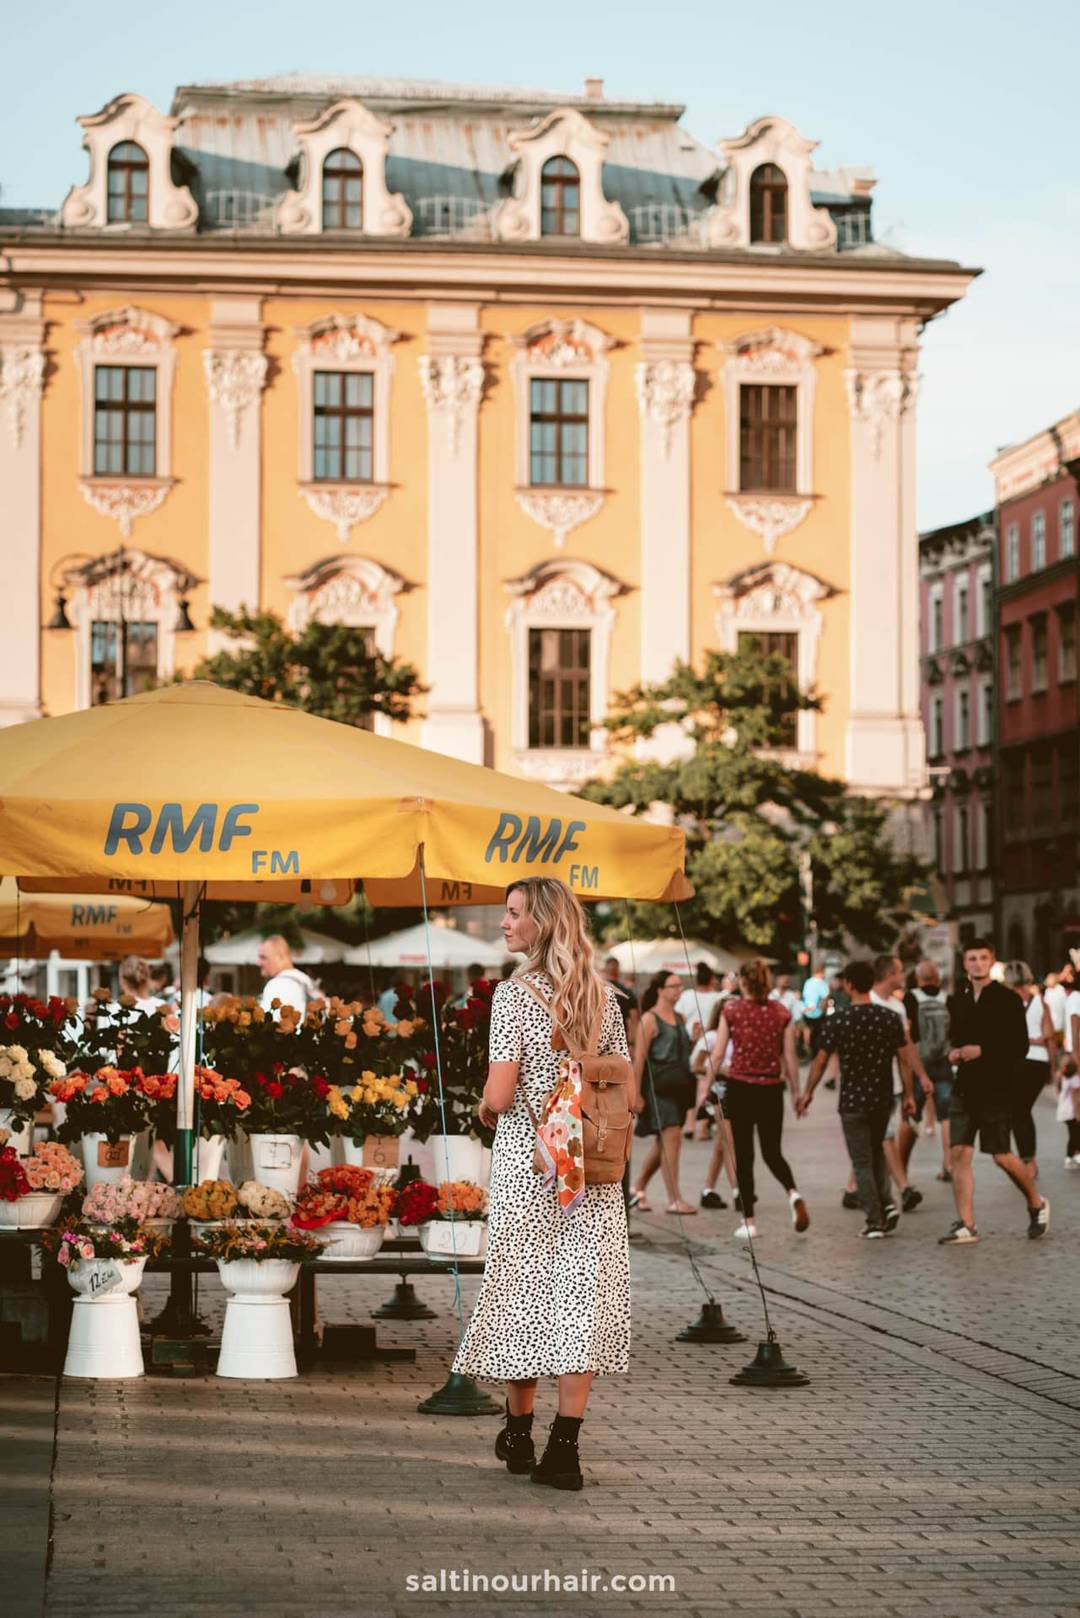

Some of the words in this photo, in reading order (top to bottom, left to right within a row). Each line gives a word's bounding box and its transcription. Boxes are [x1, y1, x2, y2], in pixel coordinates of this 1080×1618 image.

[104, 803, 259, 855] RMF
[252, 851, 299, 873] FM
[484, 813, 586, 863] RMF
[569, 864, 599, 888] FM
[71, 903, 117, 927] RMF
